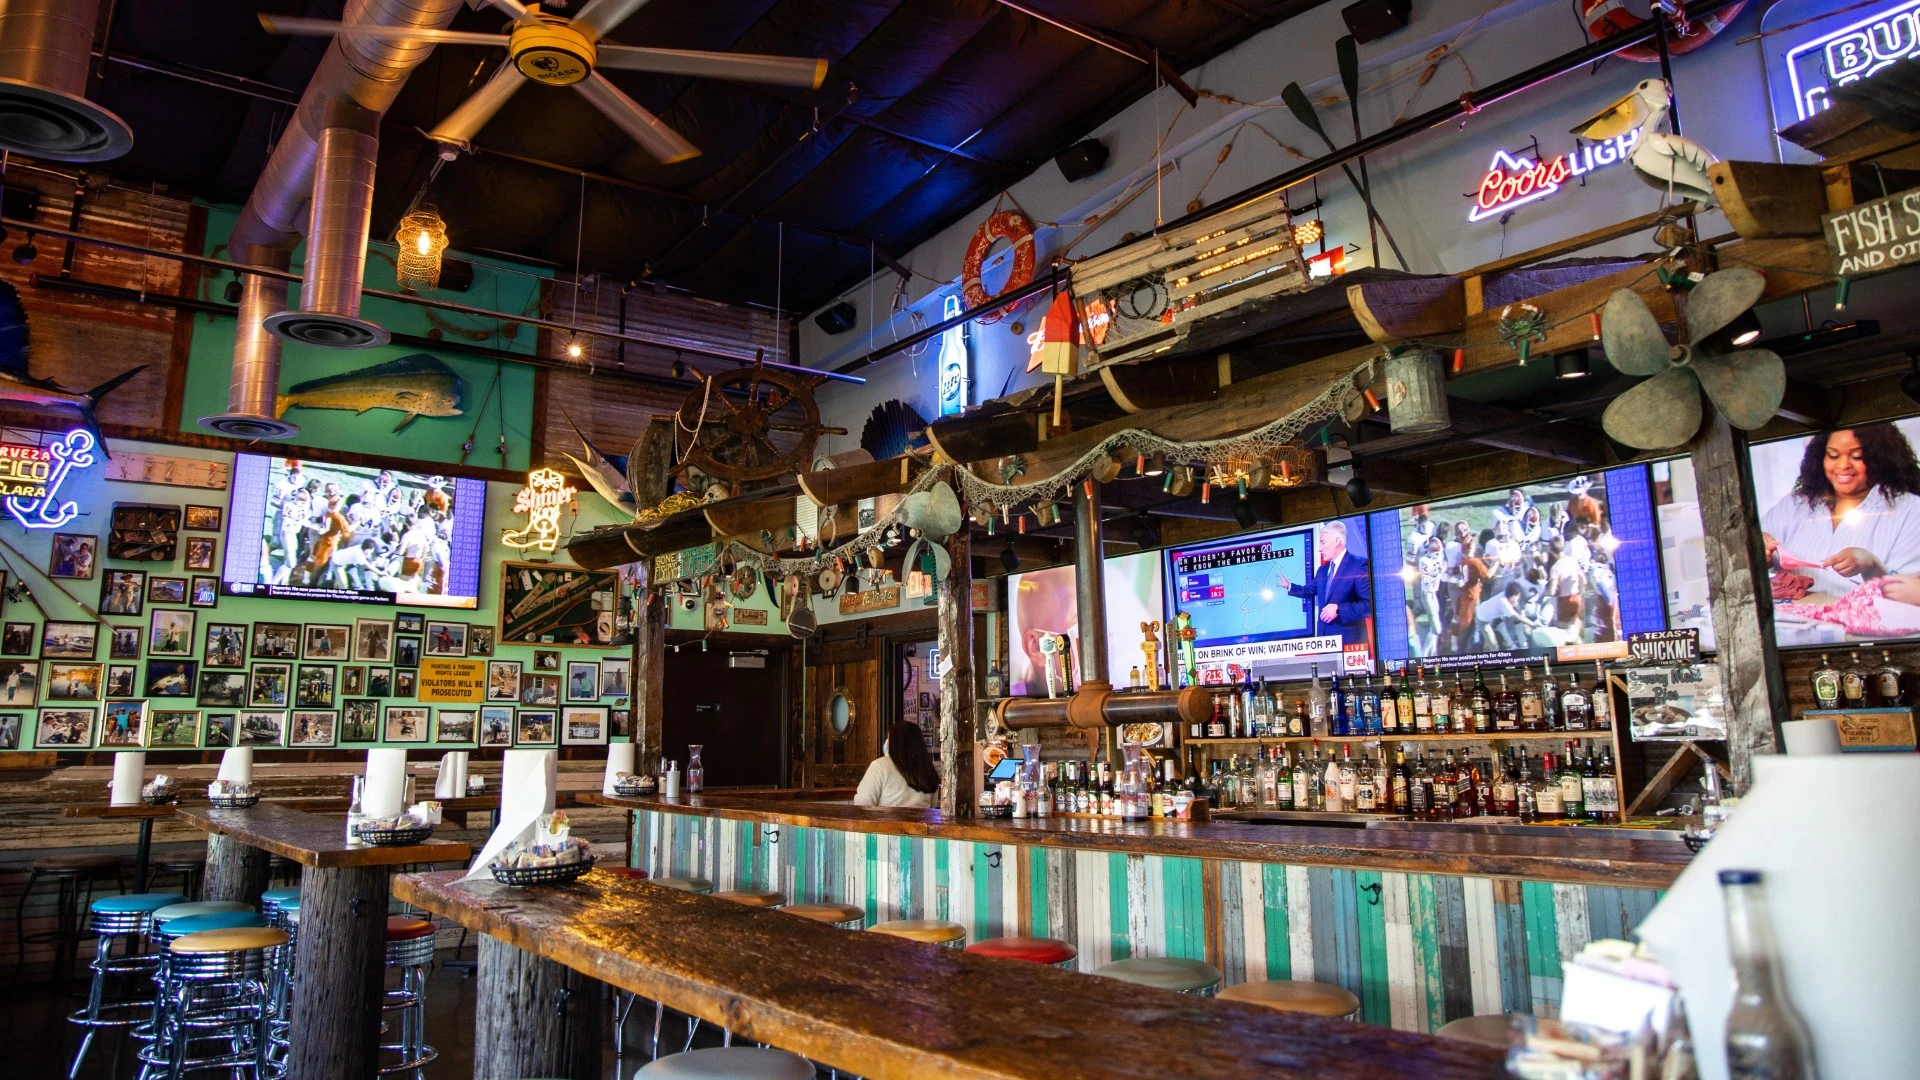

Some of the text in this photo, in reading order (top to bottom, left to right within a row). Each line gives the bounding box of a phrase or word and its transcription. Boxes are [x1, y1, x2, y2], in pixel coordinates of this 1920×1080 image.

[1826, 8, 1920, 79] BU
[559, 68, 580, 77] ASS
[1479, 127, 1643, 209] Coors LIGH
[1830, 191, 1920, 256] FISH S
[1839, 240, 1920, 275] AND OT
[513, 486, 577, 513] Shiner
[655, 553, 676, 567] GONE
[680, 552, 715, 577] LATER
[1192, 552, 1226, 563] BIDEN'S
[1192, 562, 1212, 571] KNOW
[1217, 559, 1231, 567] THE
[1236, 556, 1256, 565] MATH
[1261, 549, 1293, 560] EXISTS
[1643, 631, 1681, 640] TEXAS
[1198, 651, 1209, 659] ON
[1210, 649, 1234, 659] BRINK
[1235, 647, 1246, 656] OF
[1248, 646, 1266, 655] WIN;
[1268, 642, 1304, 653] WAITING
[1306, 641, 1323, 650] FOR
[1325, 639, 1338, 649] PA
[1632, 639, 1695, 660] SHUCKME
[1346, 655, 1366, 666] CNN
[421, 679, 455, 687] VIOLATORS
[475, 680, 483, 688] BE
[1206, 671, 1223, 680] 213
[431, 688, 472, 697] PROSECUTED
